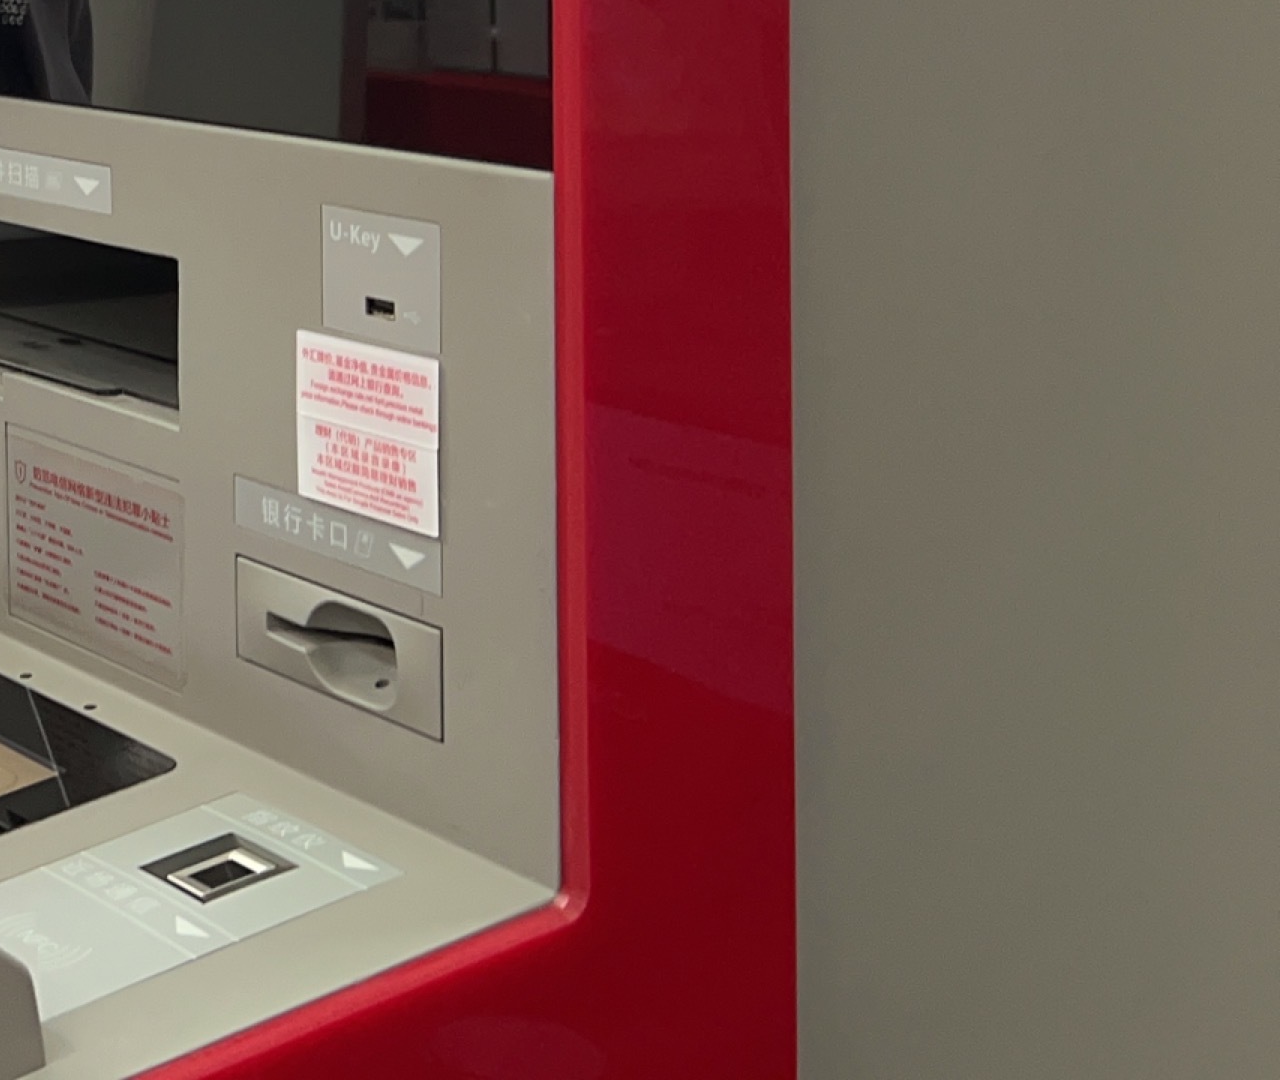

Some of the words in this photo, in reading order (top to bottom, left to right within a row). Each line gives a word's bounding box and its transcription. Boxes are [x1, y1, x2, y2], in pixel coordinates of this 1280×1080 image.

[329, 220, 381, 253] U-Key
[262, 495, 348, 551] 银行卡口
